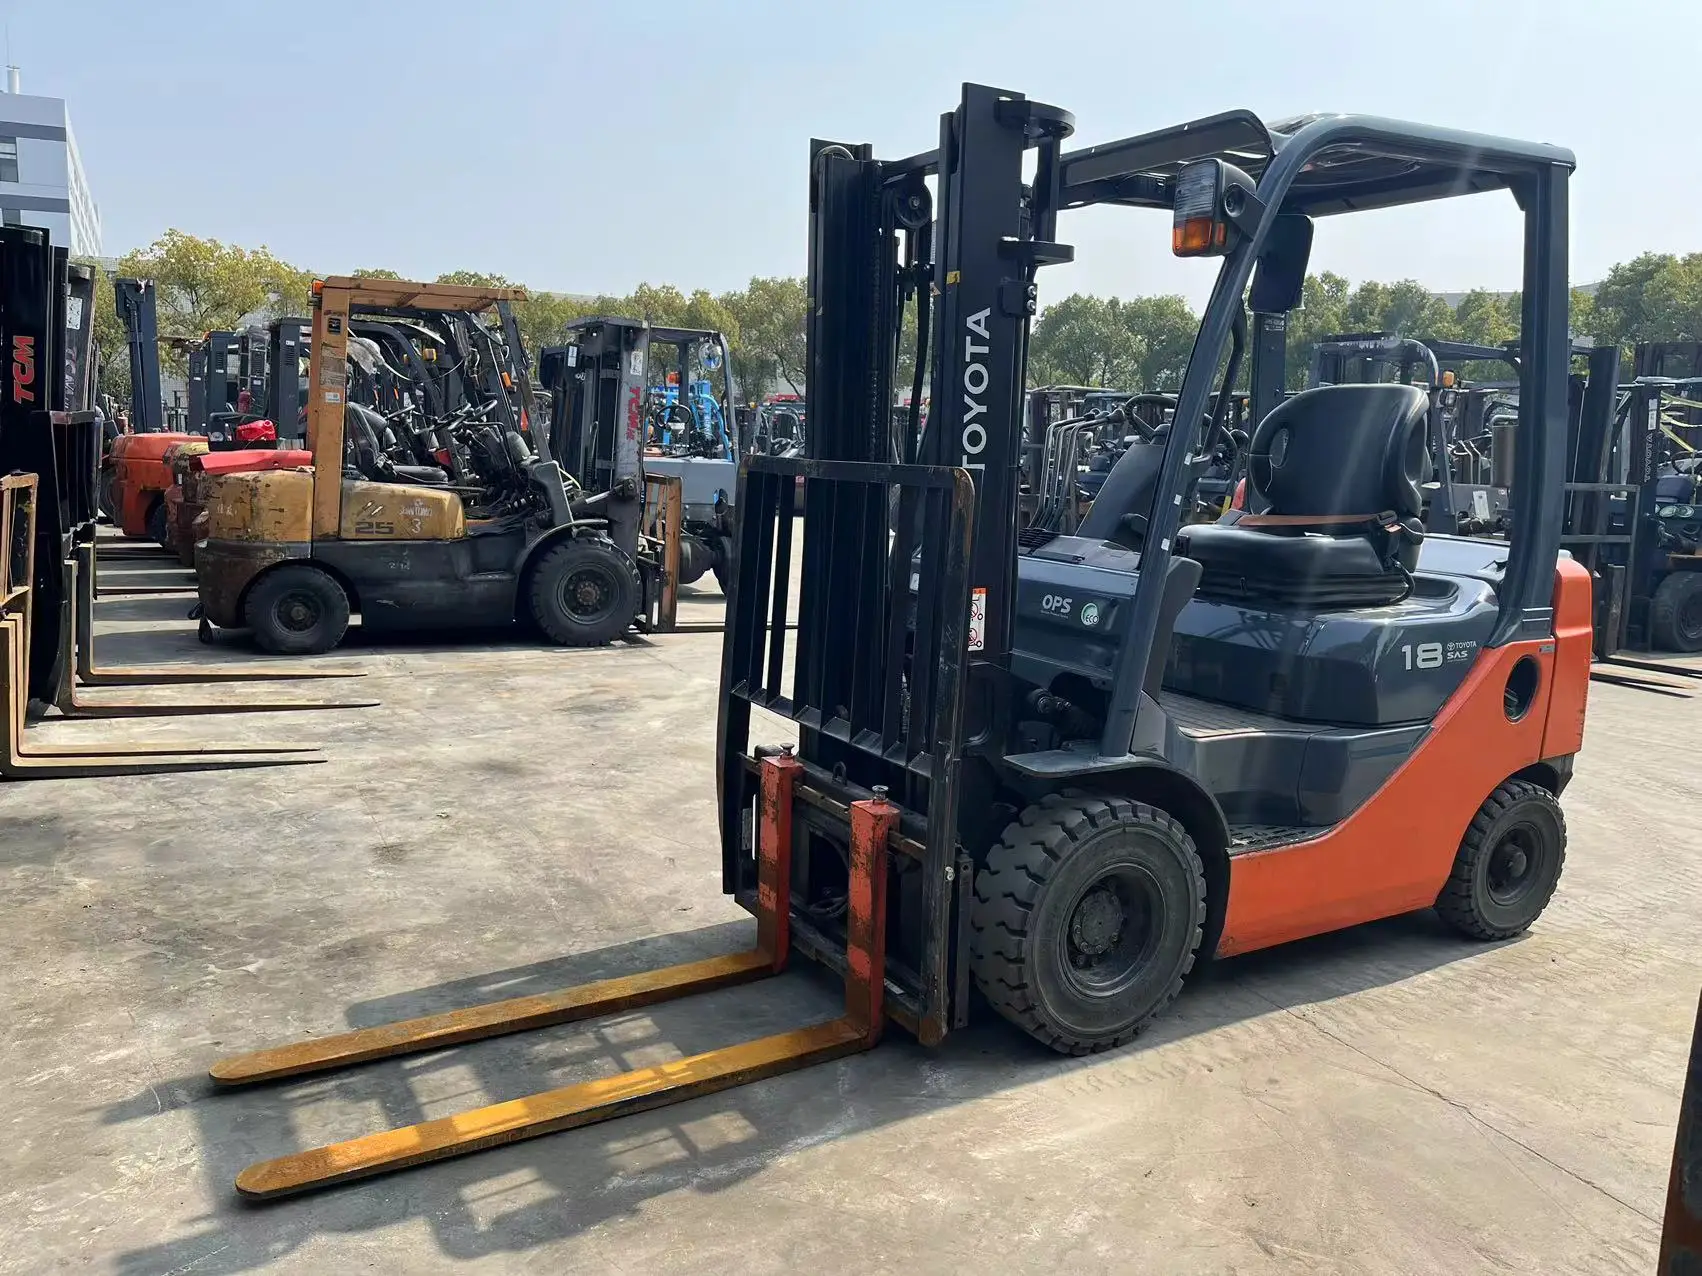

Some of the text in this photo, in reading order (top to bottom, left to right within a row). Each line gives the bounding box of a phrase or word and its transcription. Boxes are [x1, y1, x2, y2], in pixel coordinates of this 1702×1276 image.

[13, 335, 34, 404] TCM
[962, 307, 991, 471] TOYOTA
[1644, 432, 1653, 483] TOYOTA
[355, 521, 394, 535] 25
[411, 518, 421, 534] 3
[1042, 594, 1073, 614] OPS
[1455, 640, 1477, 649] TOYOTA
[1401, 642, 1443, 670] 18
[1446, 650, 1468, 660] SAS
